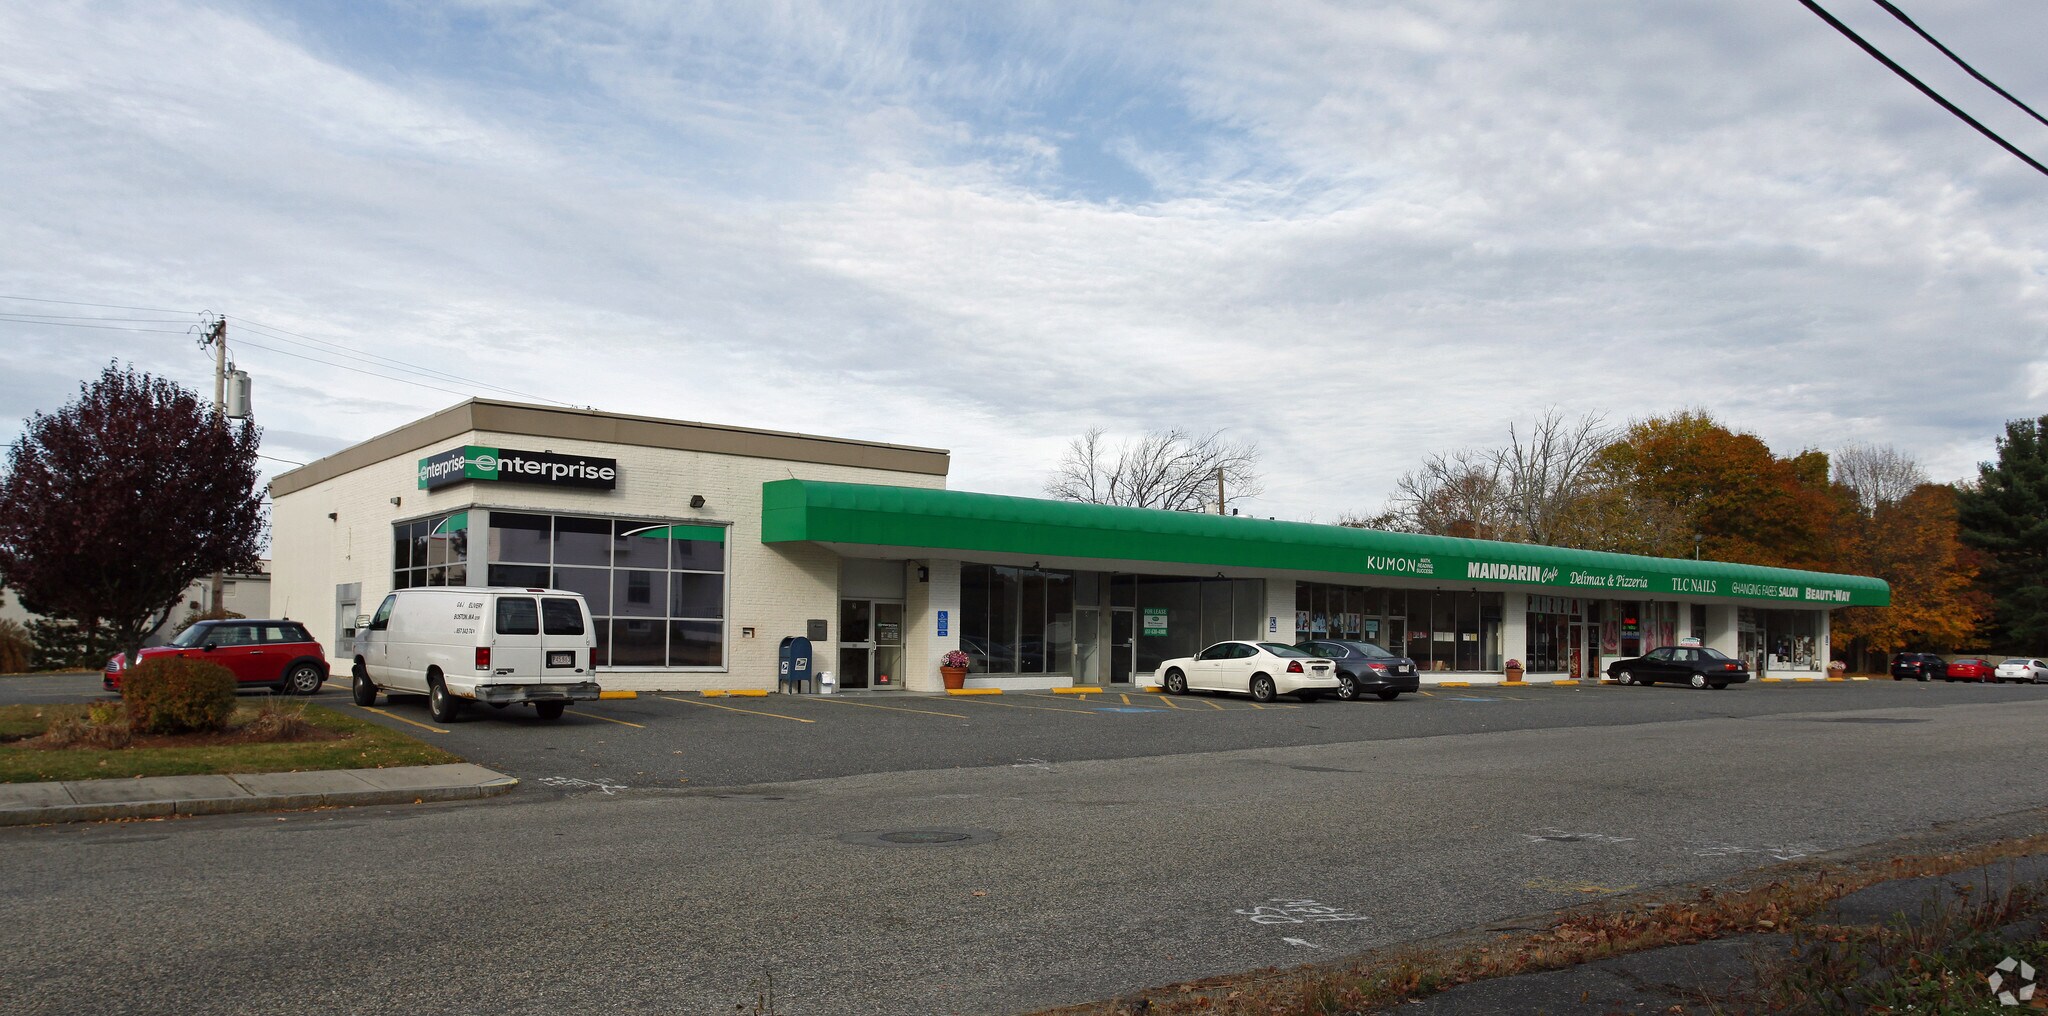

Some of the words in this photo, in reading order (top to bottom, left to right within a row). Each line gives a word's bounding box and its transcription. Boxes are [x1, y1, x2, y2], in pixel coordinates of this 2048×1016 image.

[419, 455, 465, 481] enterprise
[466, 454, 615, 481] enterprise
[1367, 555, 1416, 572] KUMON
[1468, 562, 1541, 582] MANDARIN
[1569, 571, 1606, 586] Delimax
[1607, 574, 1614, 587] &
[1615, 574, 1648, 588] Pizzeria
[1671, 577, 1690, 592] TLC
[1690, 578, 1717, 593] NAILS
[1731, 581, 1761, 596] CHANGING
[1762, 584, 1778, 597] FACES
[1778, 586, 1798, 598] SALON
